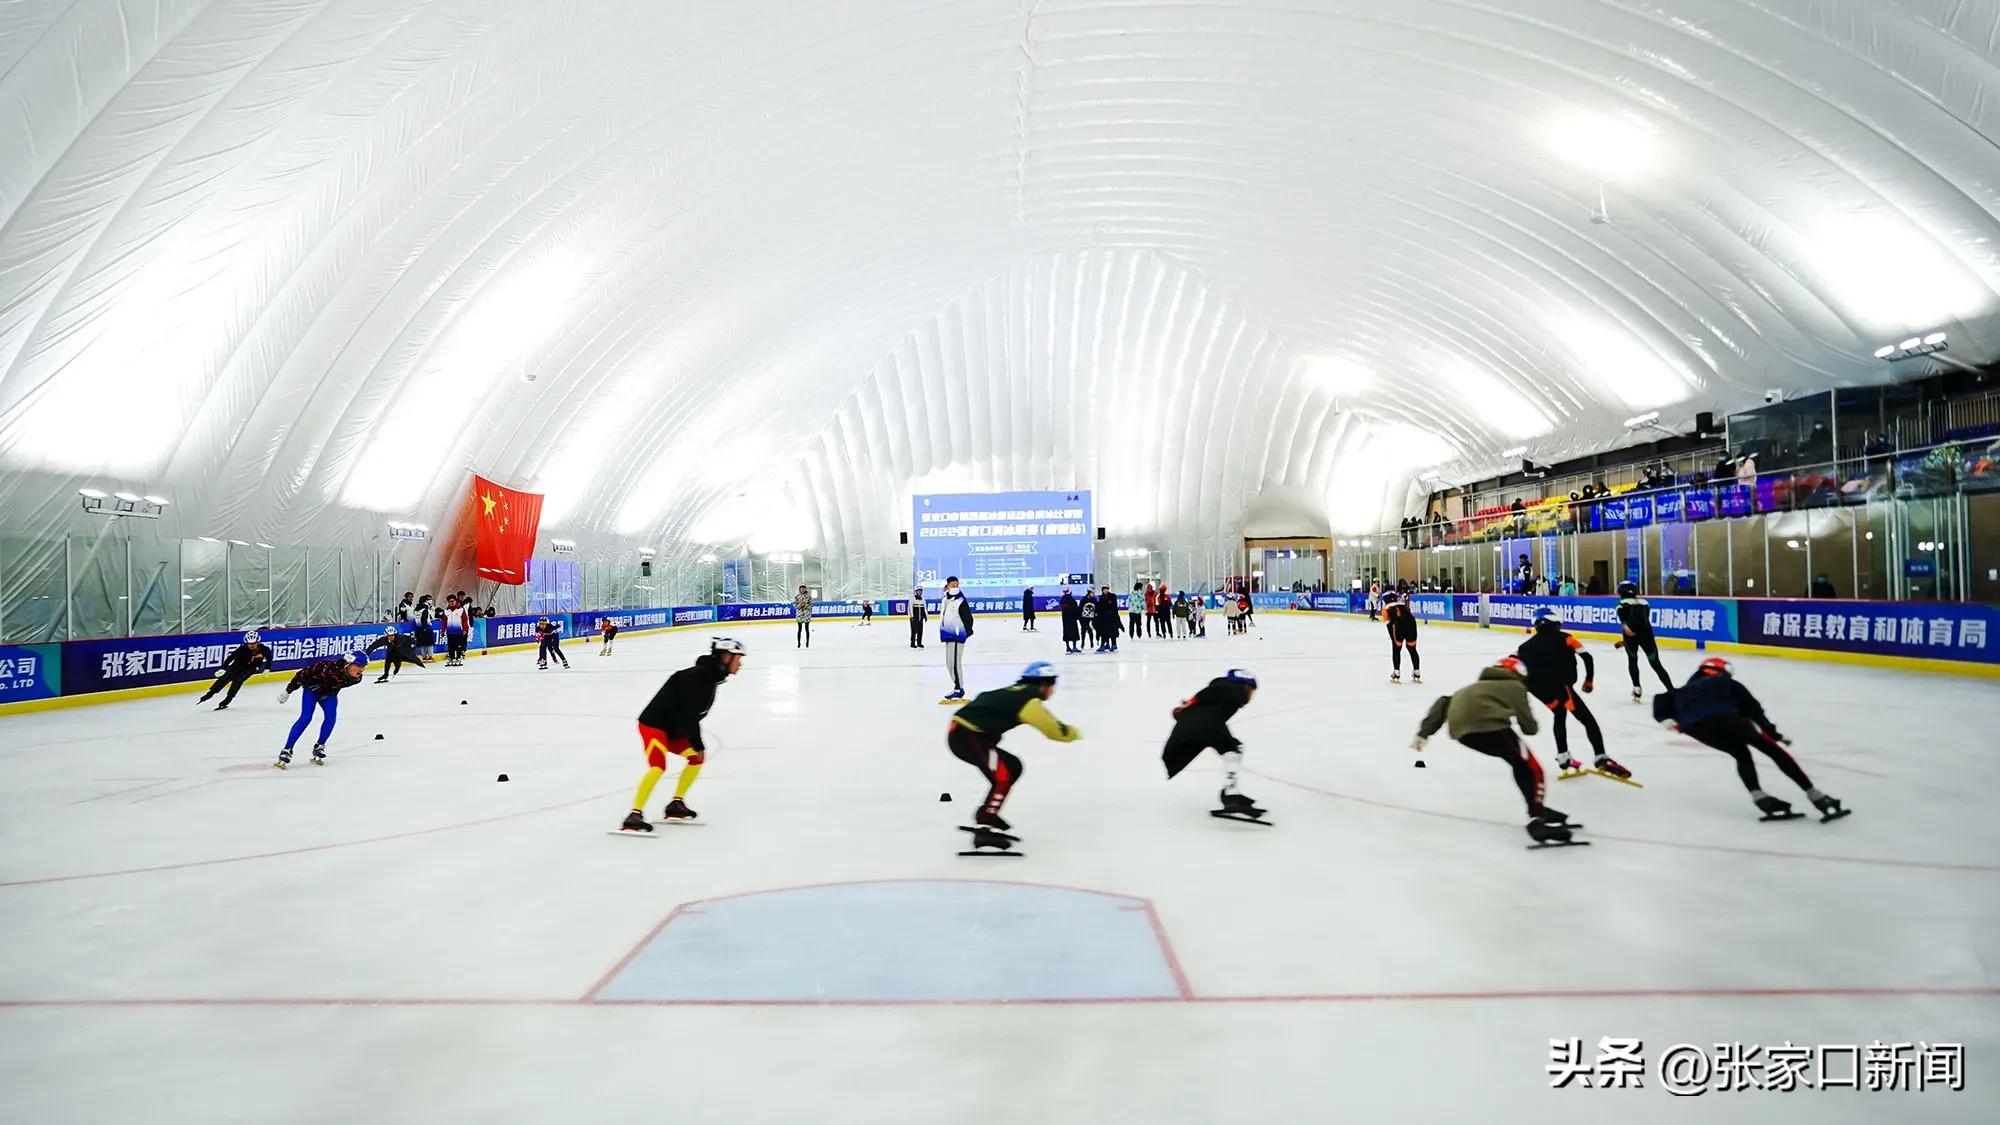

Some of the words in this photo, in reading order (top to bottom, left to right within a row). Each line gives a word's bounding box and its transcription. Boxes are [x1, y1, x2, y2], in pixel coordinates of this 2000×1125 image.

[917, 570, 936, 581] 9:31
[1763, 612, 1987, 649] 康保县教育和体育局
[12, 679, 34, 689] LTD
